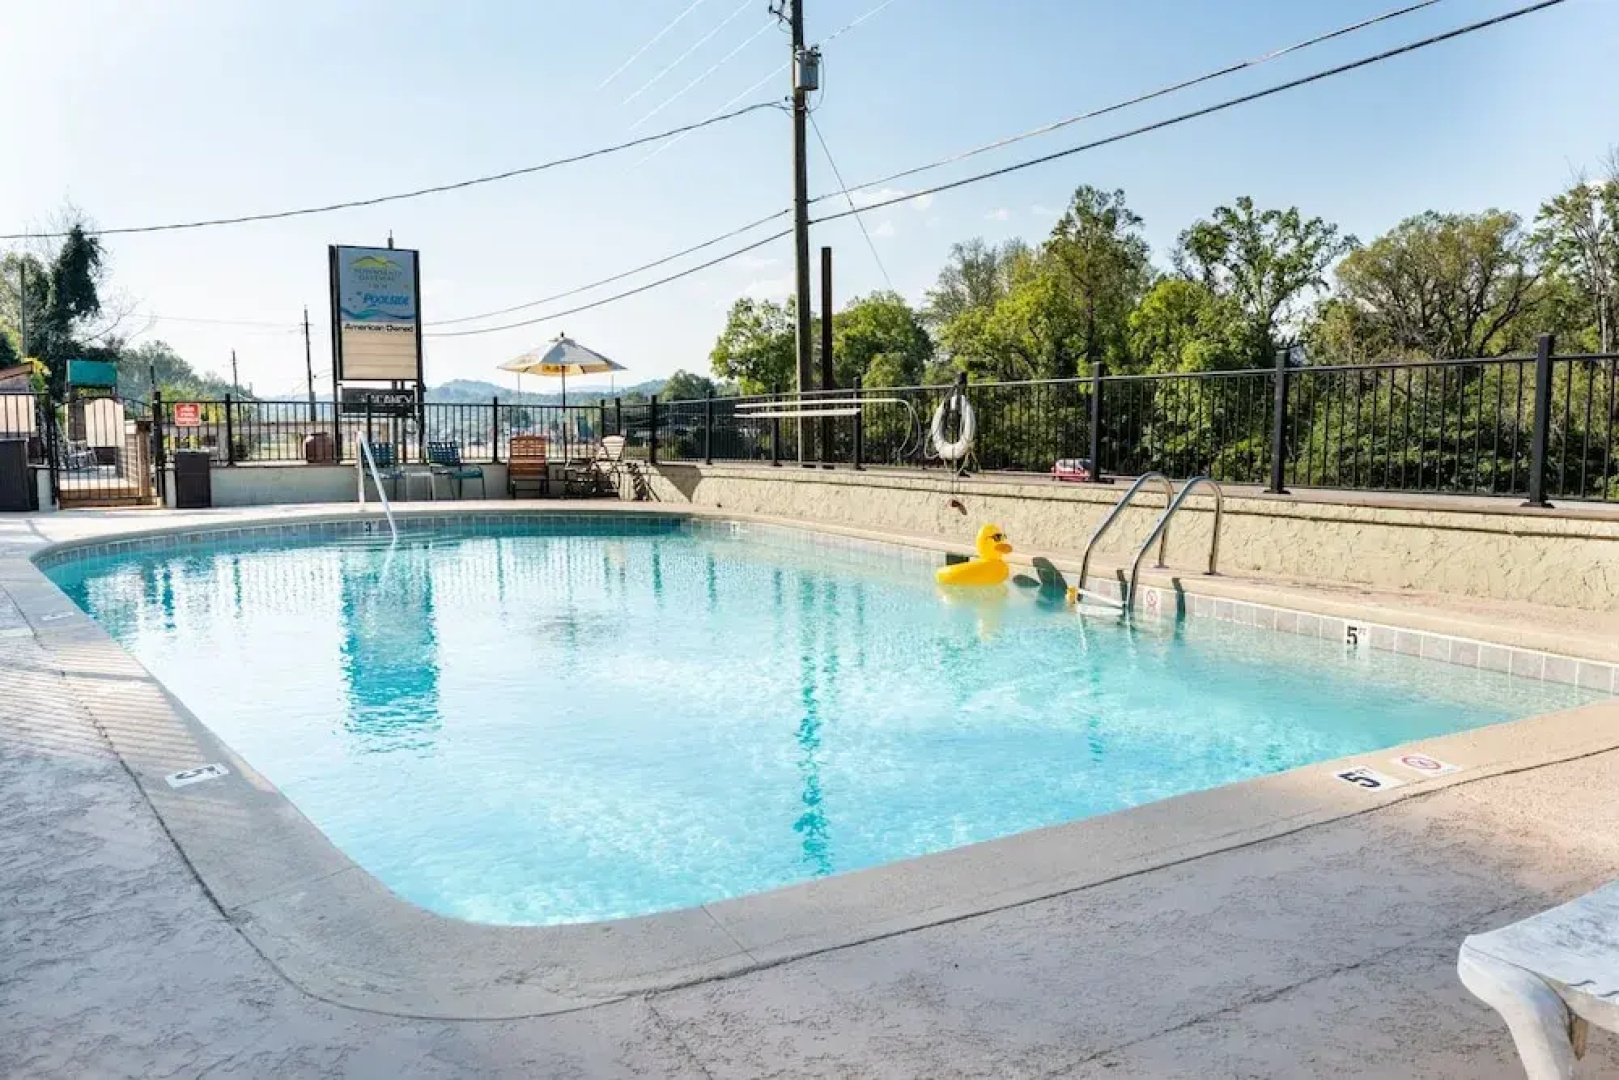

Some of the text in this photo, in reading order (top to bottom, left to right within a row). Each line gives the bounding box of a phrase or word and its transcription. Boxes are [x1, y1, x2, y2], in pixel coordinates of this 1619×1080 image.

[345, 323, 413, 333] American Owned
[1346, 625, 1358, 645] 5
[1338, 771, 1381, 788] 5
